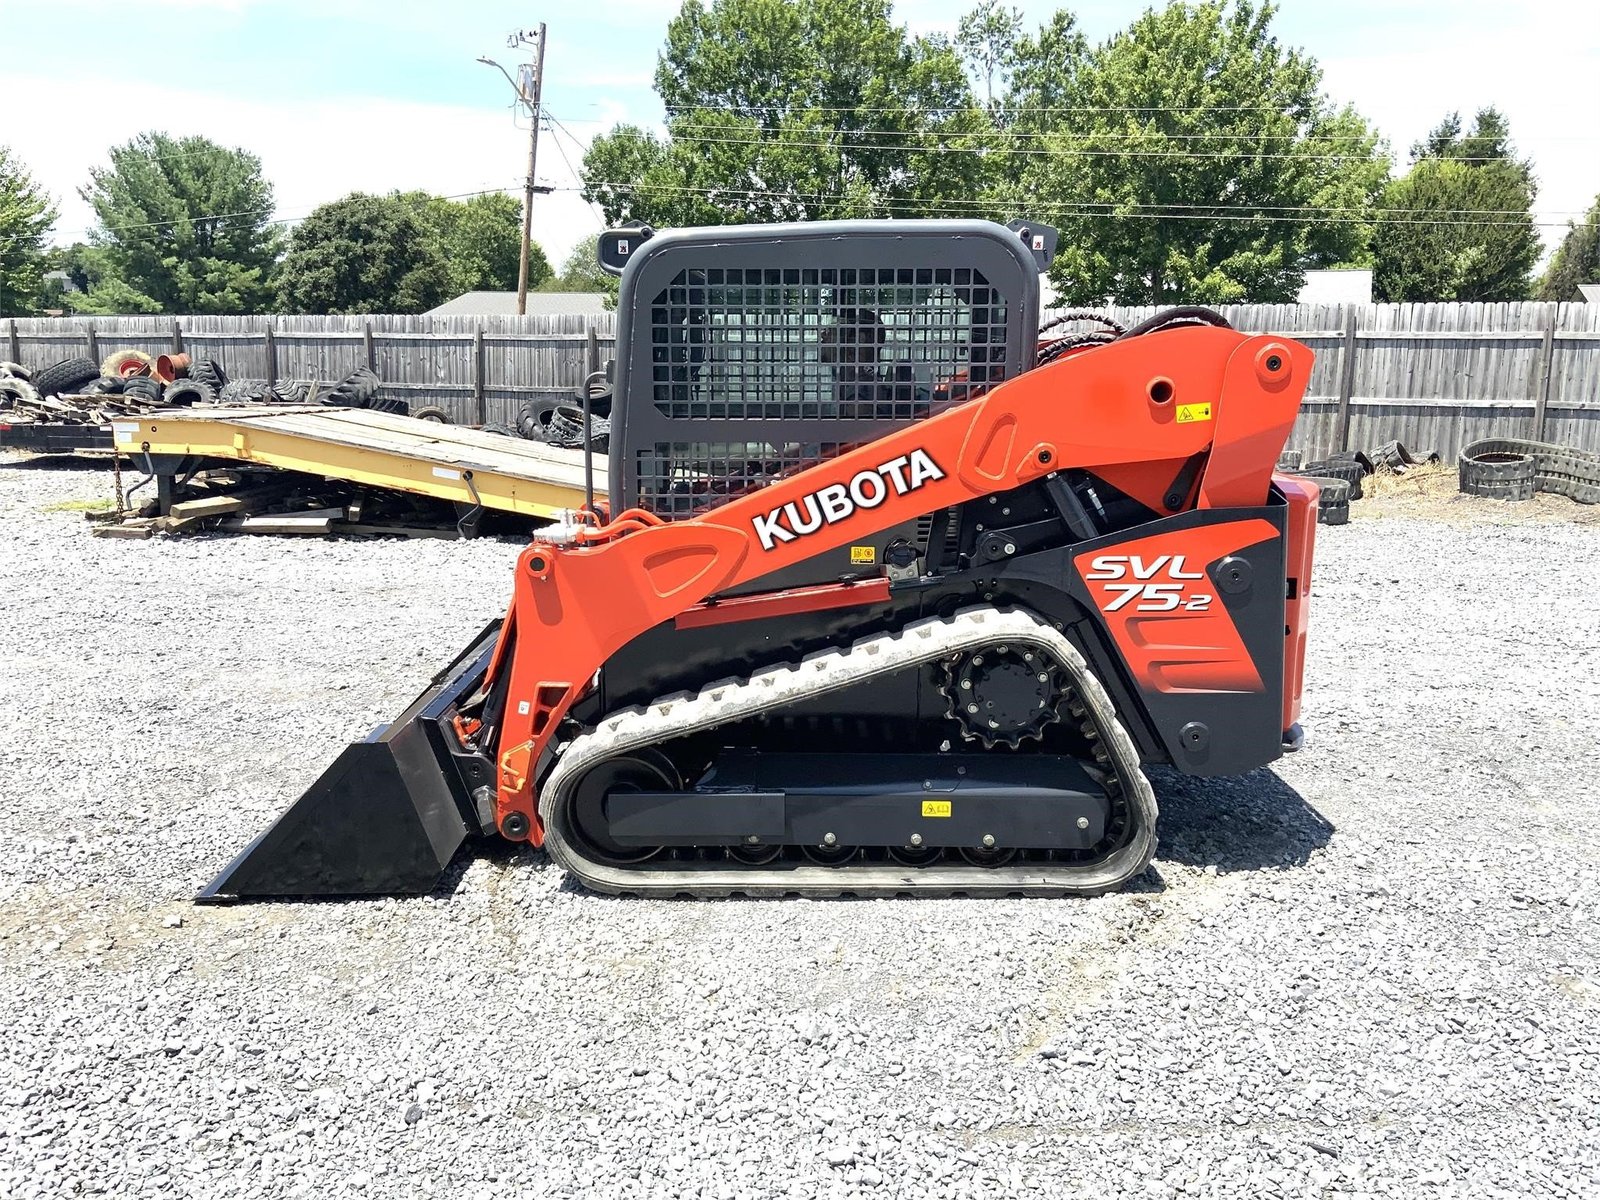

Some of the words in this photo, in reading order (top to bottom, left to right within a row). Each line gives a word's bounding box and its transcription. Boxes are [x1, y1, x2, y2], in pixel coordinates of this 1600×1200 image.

[752, 449, 945, 550] KUBOTA
[1086, 555, 1204, 580] SVL
[1103, 584, 1213, 612] 75-2
